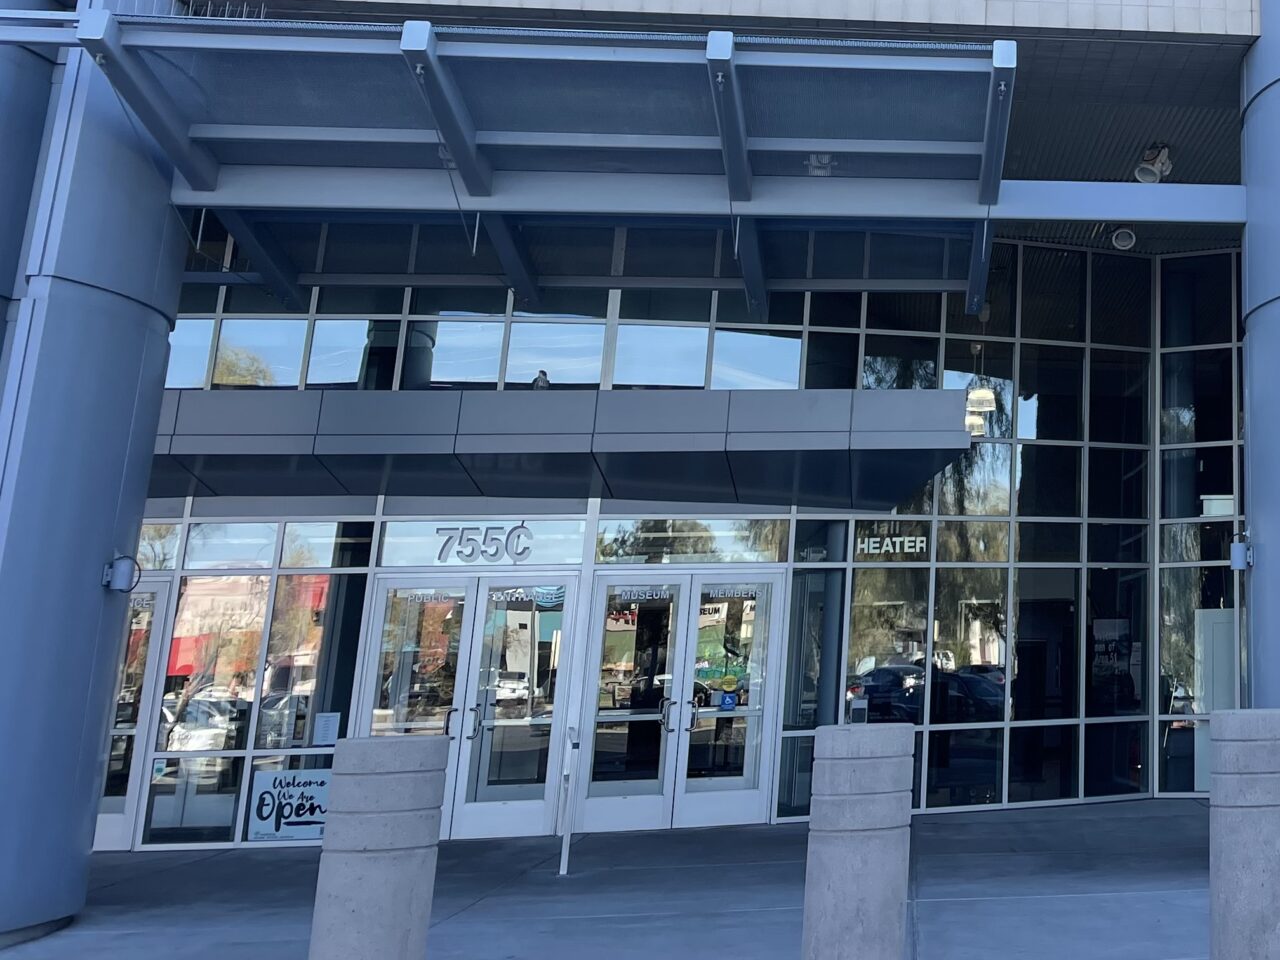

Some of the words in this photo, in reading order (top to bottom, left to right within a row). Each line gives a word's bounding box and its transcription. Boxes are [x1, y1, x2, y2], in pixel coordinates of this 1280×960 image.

[407, 593, 450, 603] PUBLIC
[621, 590, 670, 600] MUSEUM
[709, 589, 762, 599] MEMBERS
[273, 775, 327, 789] Welcome
[277, 790, 295, 800] We
[297, 791, 316, 802] Are
[256, 791, 327, 832] Open
